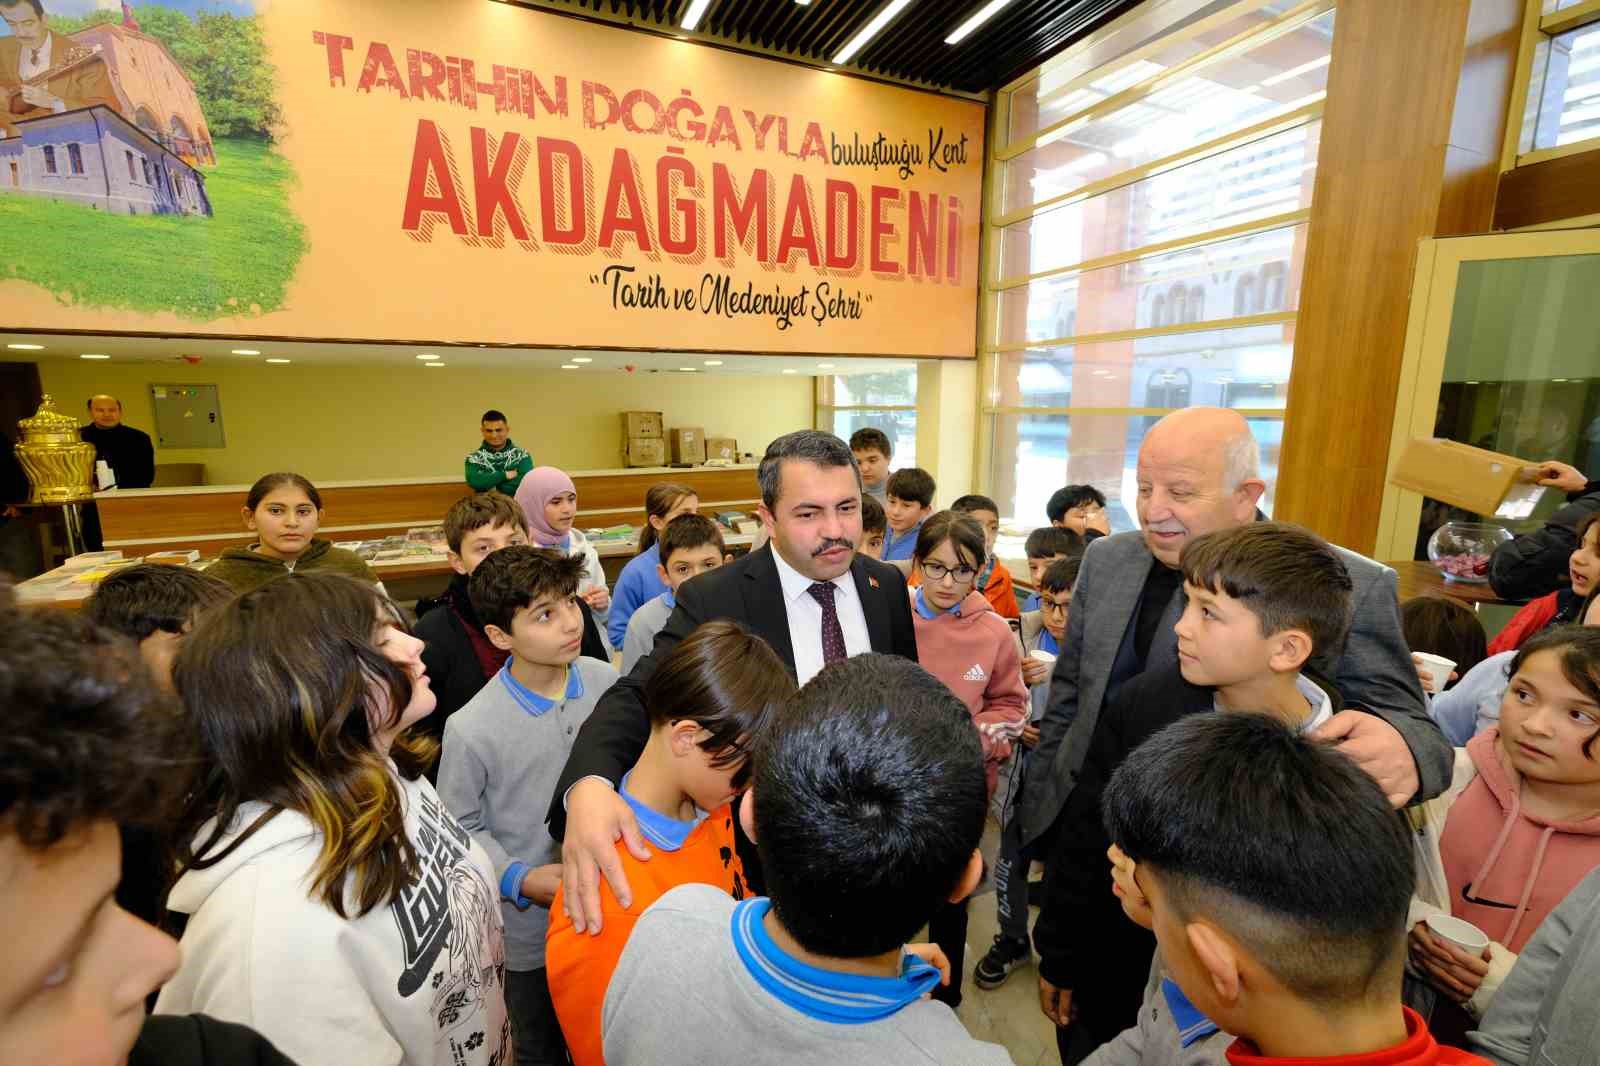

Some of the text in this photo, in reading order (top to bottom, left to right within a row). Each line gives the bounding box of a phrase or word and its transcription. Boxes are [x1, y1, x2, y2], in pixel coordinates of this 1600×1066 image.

[581, 79, 830, 165] DOĞAYLA
[928, 127, 968, 173] Kent
[674, 289, 697, 311] ve
[699, 273, 810, 331] Medeniyet
